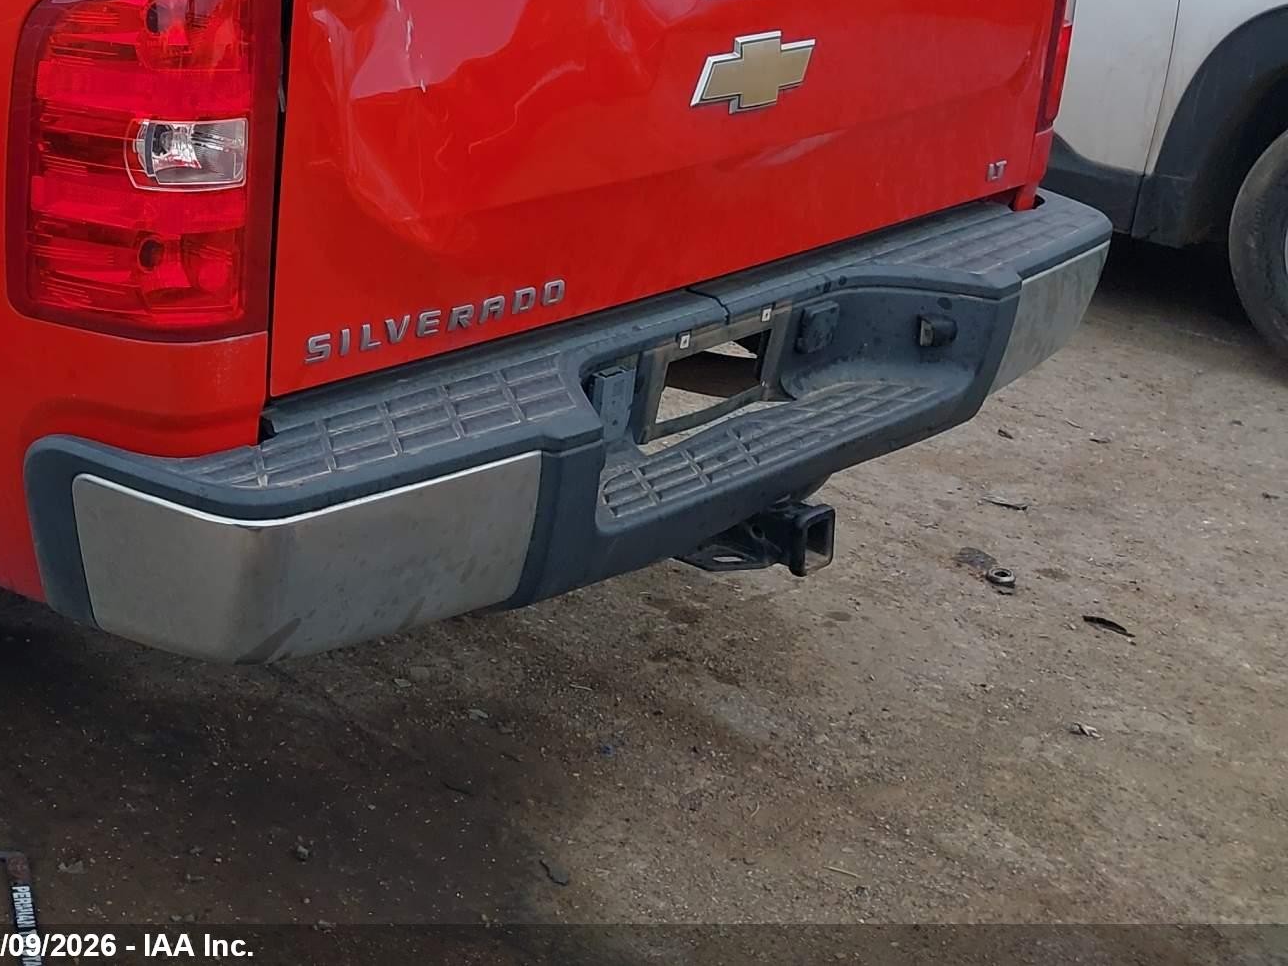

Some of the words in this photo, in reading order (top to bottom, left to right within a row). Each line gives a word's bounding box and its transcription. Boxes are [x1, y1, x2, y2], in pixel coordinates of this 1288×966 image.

[987, 160, 1008, 182] LT
[304, 278, 566, 364] SILVERADO
[12, 885, 37, 928] PERMIAN
